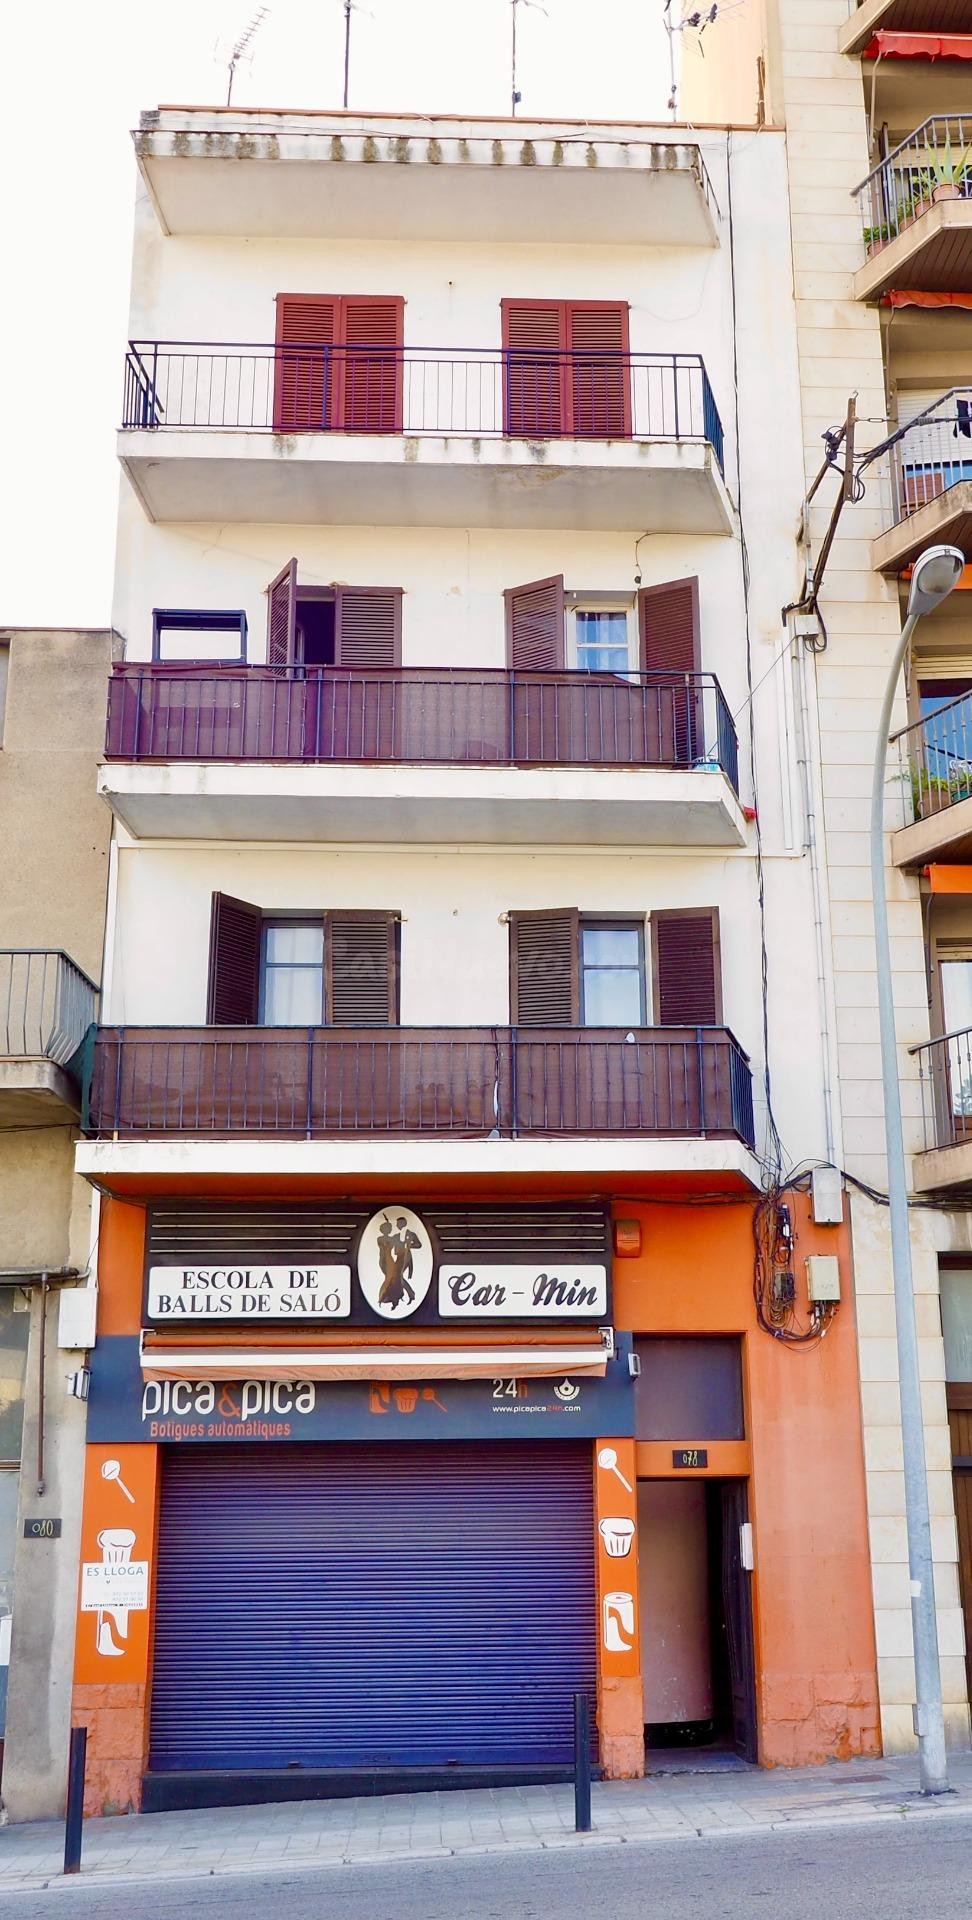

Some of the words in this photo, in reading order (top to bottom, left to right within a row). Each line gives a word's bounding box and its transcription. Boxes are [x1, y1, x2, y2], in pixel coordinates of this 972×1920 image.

[182, 1270, 274, 1289] ESCOLA
[288, 1270, 319, 1289] DE
[448, 1272, 507, 1306] Car
[532, 1273, 598, 1306] Min
[158, 1294, 232, 1313] BALLS
[240, 1294, 271, 1312] DE
[279, 1288, 341, 1312] SALÓ
[492, 1403, 581, 1413] www.picapica24h.com
[150, 1421, 204, 1441] Botigues
[207, 1420, 291, 1440] automàtiques
[682, 1451, 697, 1466] 078
[32, 1519, 53, 1536] 080
[86, 1567, 100, 1577] ES
[104, 1566, 144, 1576] LLOGA
